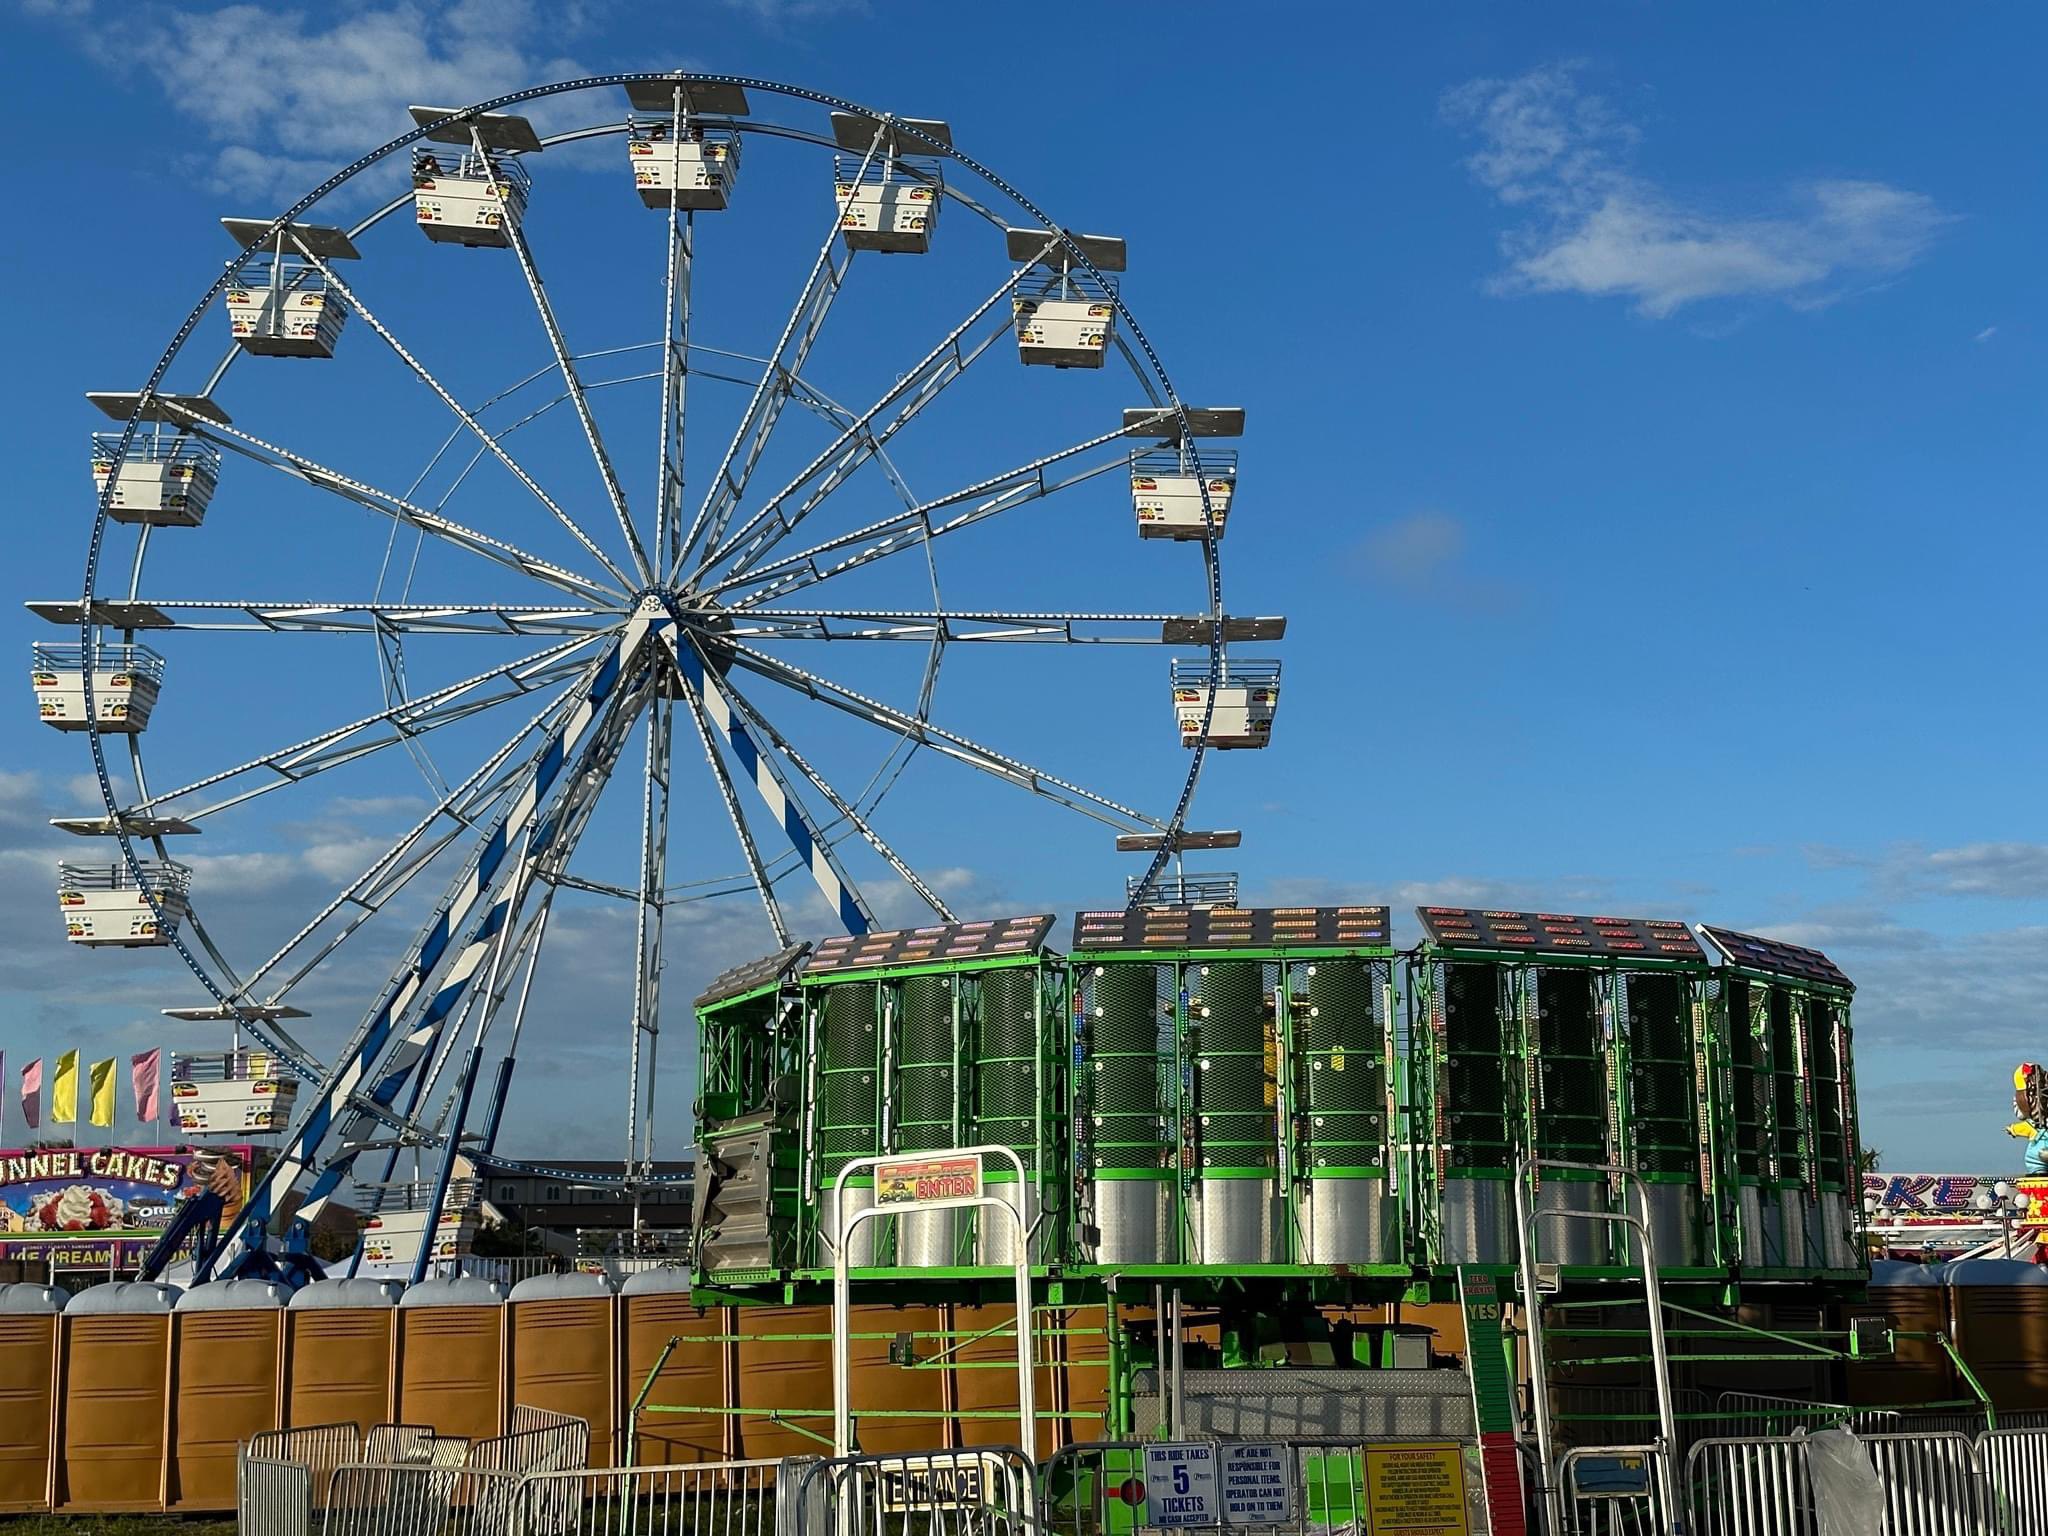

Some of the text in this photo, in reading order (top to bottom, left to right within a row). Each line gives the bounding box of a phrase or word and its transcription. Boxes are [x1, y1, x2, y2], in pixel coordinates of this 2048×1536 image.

[0, 1152, 181, 1187] NNEL CAKES
[916, 1177, 976, 1200] ENTER
[1467, 1304, 1498, 1320] YES
[1150, 1449, 1209, 1461] THIS RIDE TAKES
[1234, 1448, 1272, 1458] WE ARE NOT
[1227, 1461, 1280, 1472] RESPONSIBLE FOR
[1173, 1464, 1189, 1494] 5
[1228, 1475, 1259, 1485] PERSONAL
[1226, 1487, 1285, 1499] OPERATOR CAN NOT
[1161, 1496, 1204, 1513] TICKETS
[1230, 1501, 1283, 1512] HOLD ON TO THEM
[1168, 1515, 1181, 1523] CASH
[1183, 1514, 1208, 1522] ACCEPTED
